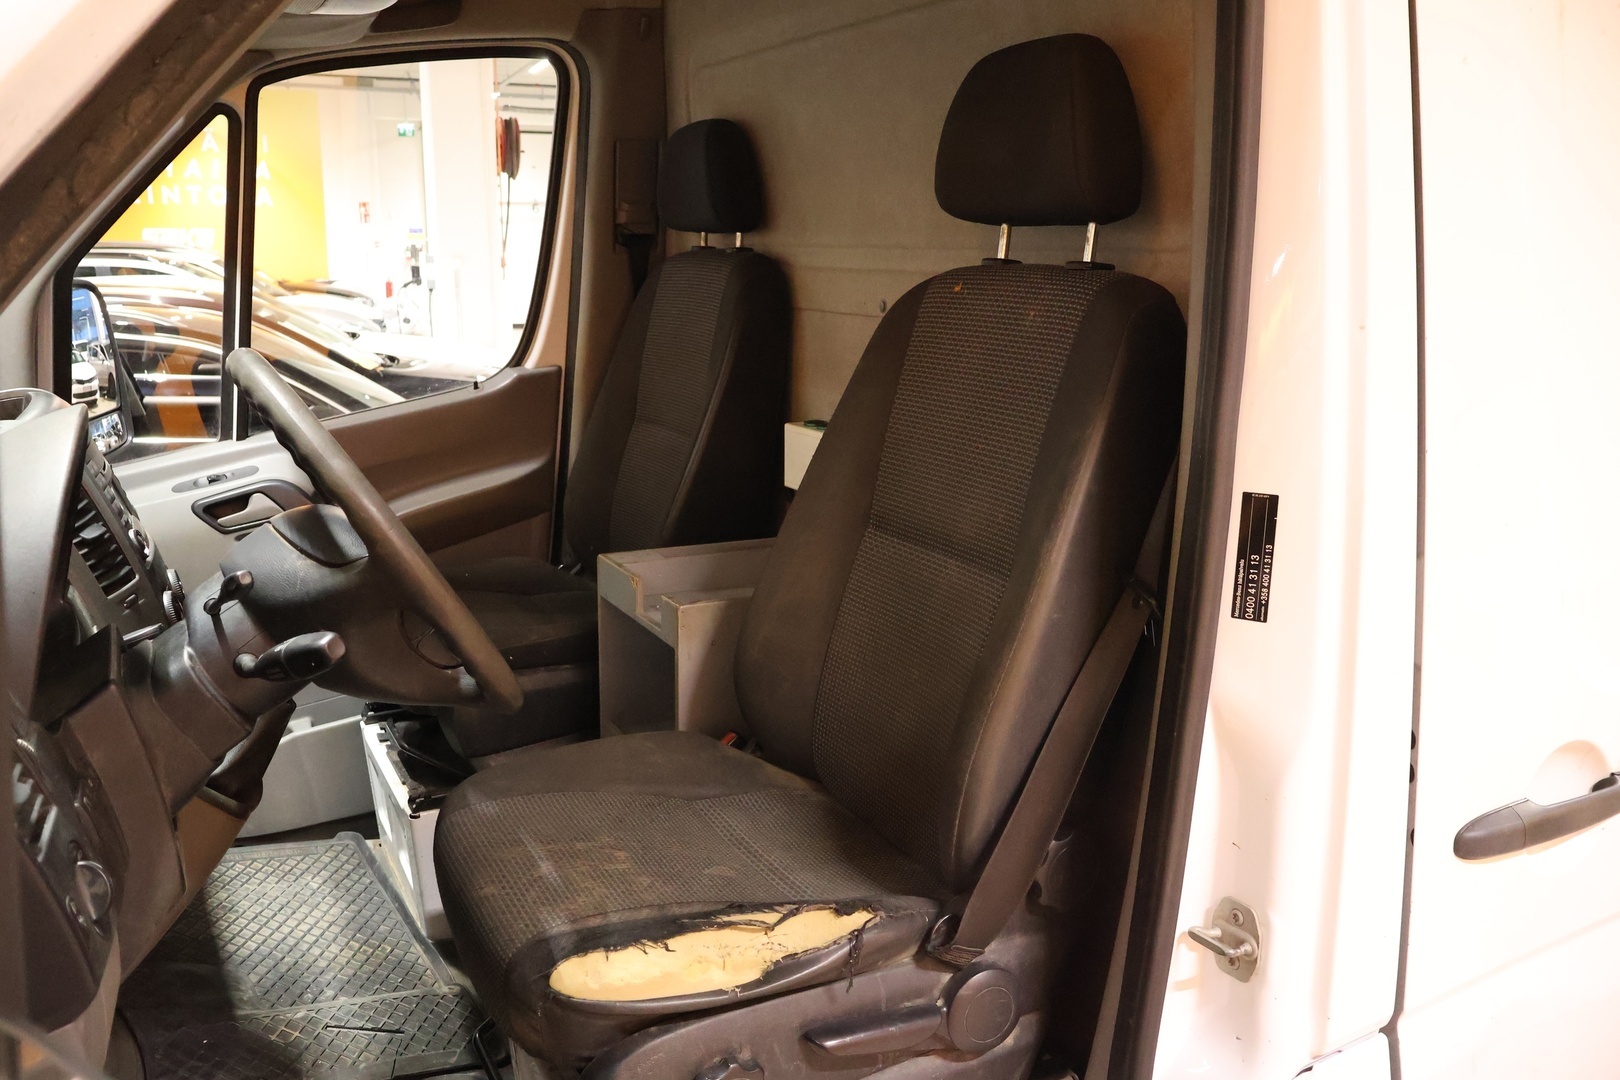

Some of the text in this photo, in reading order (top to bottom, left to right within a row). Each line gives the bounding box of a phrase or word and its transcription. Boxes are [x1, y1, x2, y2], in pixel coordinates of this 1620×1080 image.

[1265, 544, 1273, 552] 13
[1264, 555, 1272, 564] 31
[1263, 564, 1271, 573] 41
[1262, 573, 1270, 587] 400
[1245, 554, 1260, 619] 0400 41 31 13
[1260, 587, 1269, 605] +358
